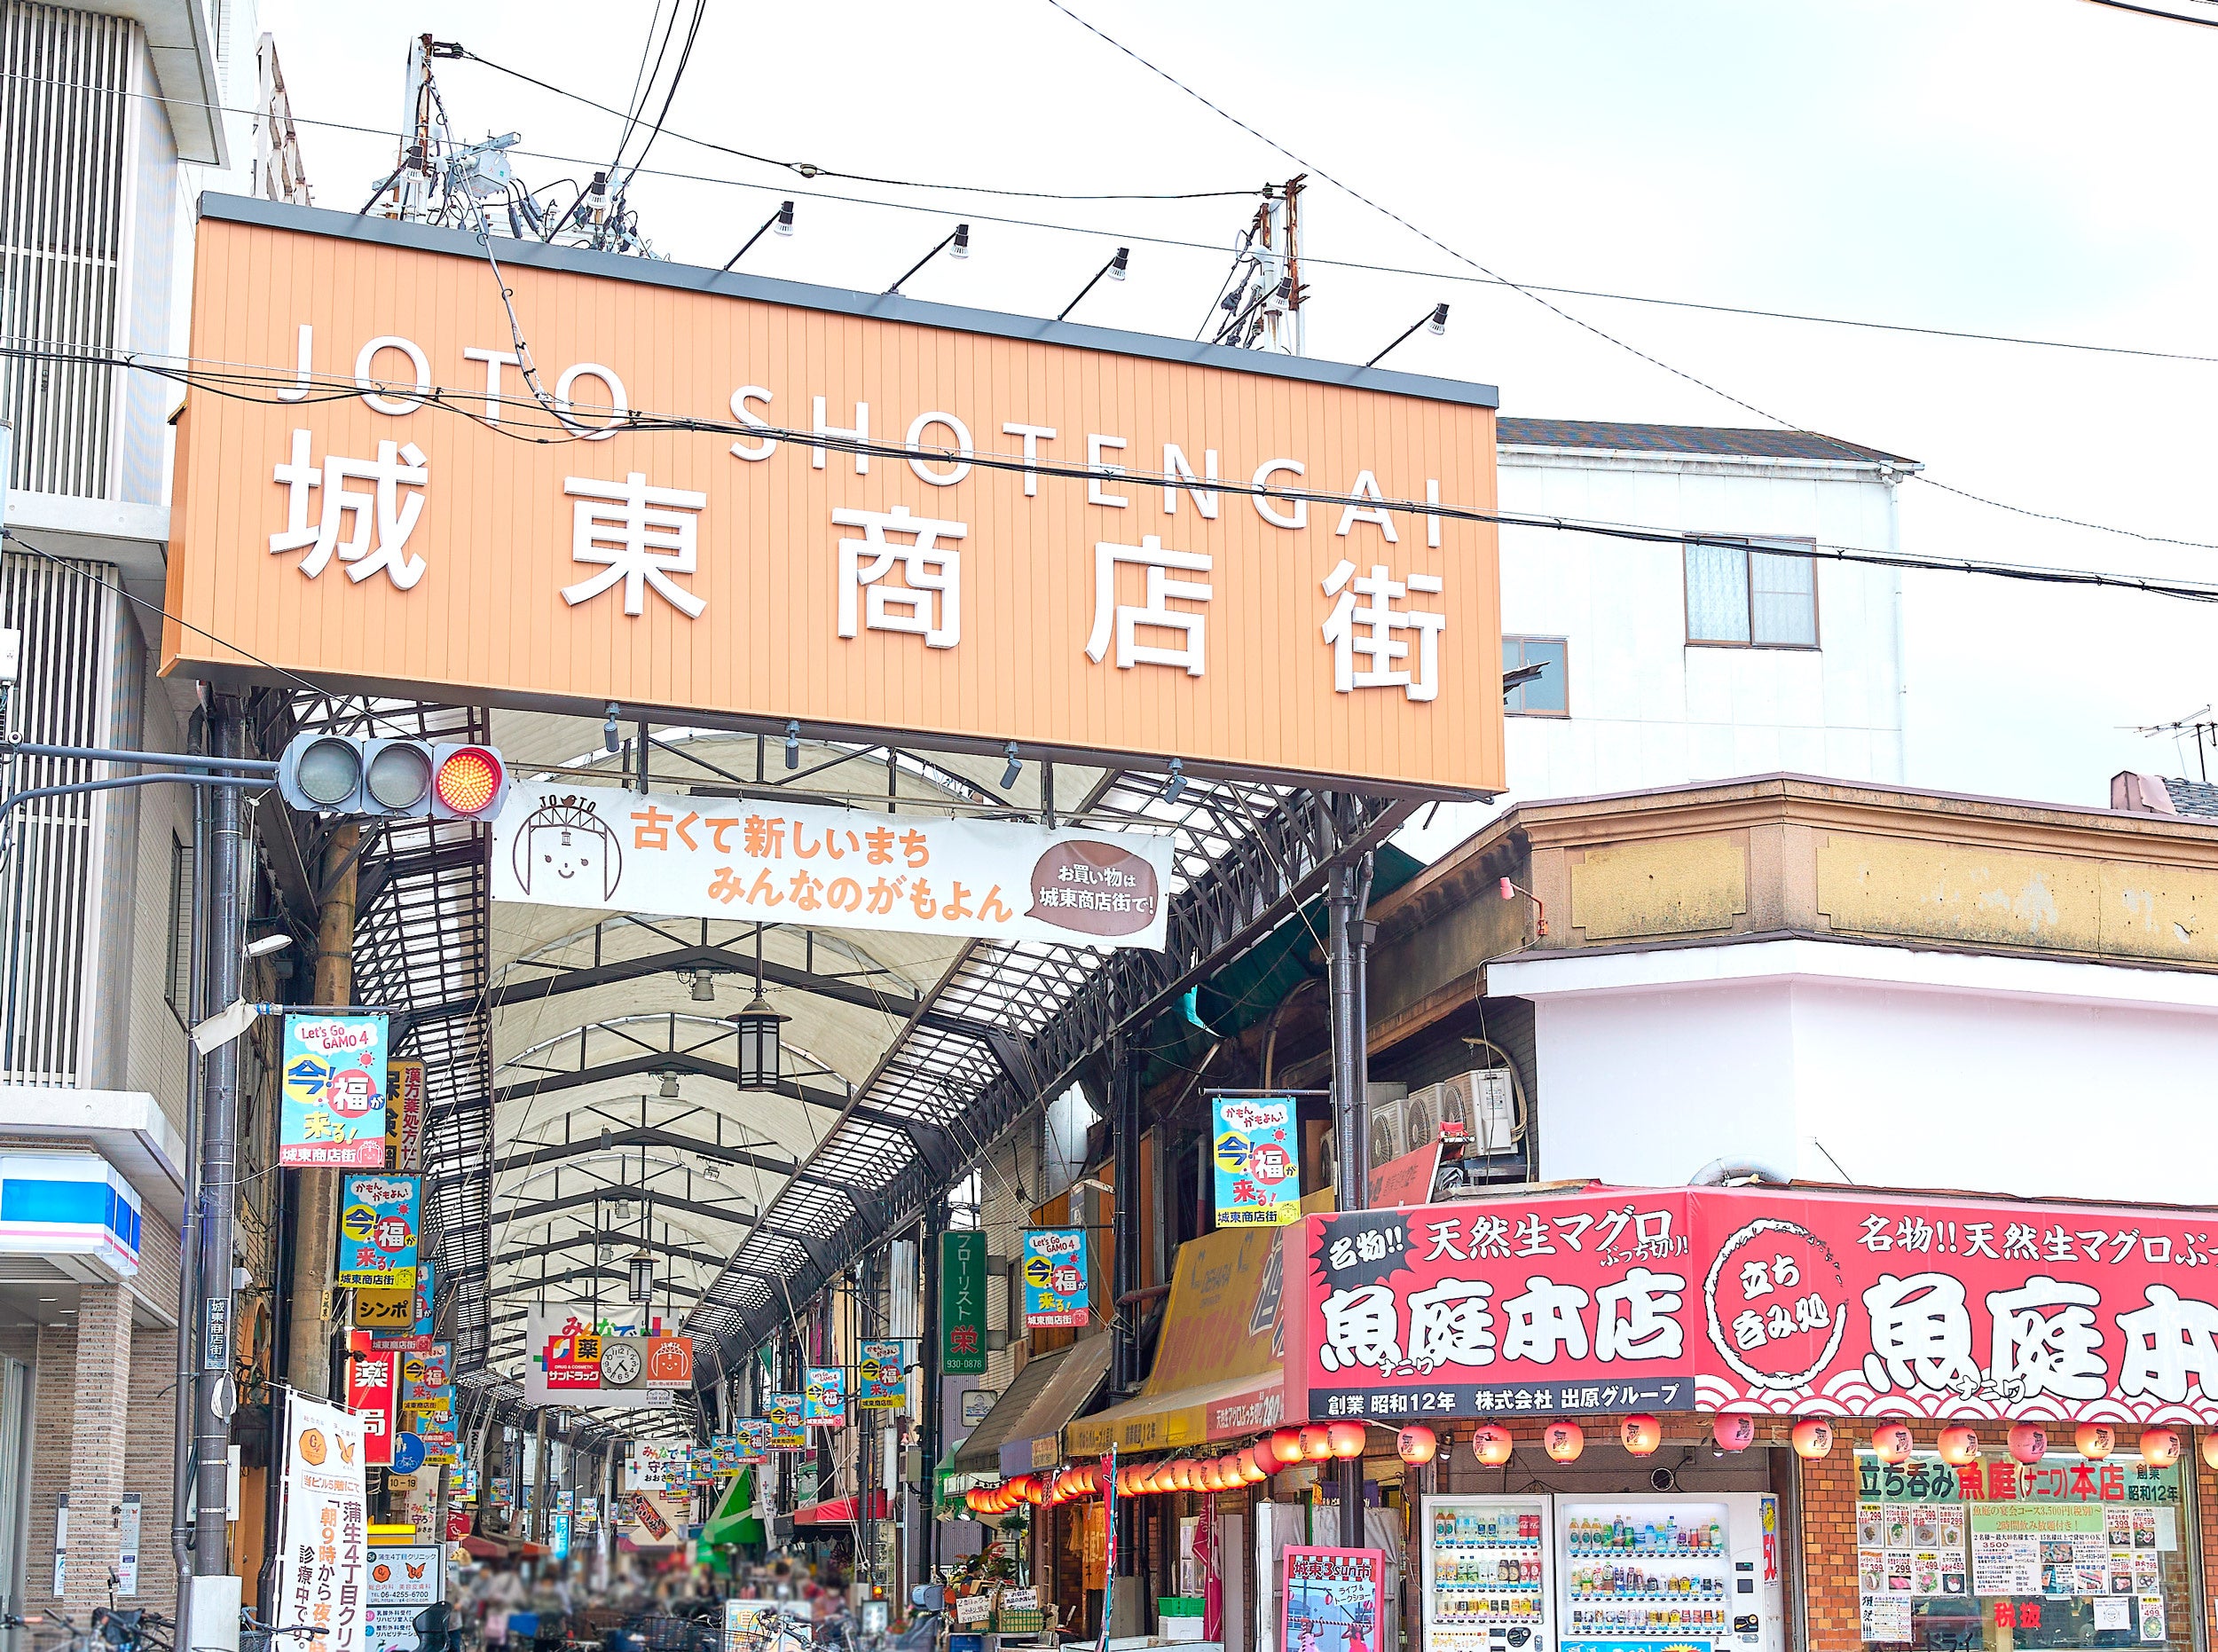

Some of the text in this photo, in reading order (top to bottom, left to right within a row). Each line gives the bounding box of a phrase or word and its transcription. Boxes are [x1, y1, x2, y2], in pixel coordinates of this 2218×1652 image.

[277, 324, 1441, 548] JOTO SHOTENGAI
[269, 429, 1446, 703] 城東商店街
[630, 806, 931, 869] 古くて新しいまち
[1058, 863, 1137, 888] お買い物は
[707, 867, 1013, 924] みんなのがもよん
[1039, 886, 1155, 915] 城東商店街で!
[302, 1025, 345, 1040] Let's Go
[323, 1031, 368, 1050] GAMO 4
[1226, 1106, 1253, 1118] かもん
[1244, 1112, 1284, 1128] がもよん!
[304, 1112, 358, 1145] 来る!
[282, 1148, 357, 1163] 城東商店街
[356, 1183, 382, 1193] かもん
[373, 1189, 409, 1201] がもよん!
[1233, 1179, 1277, 1208] 来る!
[1217, 1211, 1278, 1223] 城東商店街
[1034, 1239, 1050, 1247] Let's
[1423, 1204, 1673, 1262] 天然生マグロ
[1046, 1239, 1074, 1253] GAMO 4
[1329, 1225, 1404, 1271] 名物!!
[1601, 1235, 1688, 1267] ぶっち切り!
[357, 1247, 397, 1271] 来る!
[341, 1274, 395, 1286] 城東商店街
[1740, 1255, 1801, 1302] 立ち
[951, 1235, 978, 1354] フローリスト 栄
[1038, 1293, 1072, 1313] 来る!
[359, 1300, 409, 1318] シンポ
[1027, 1315, 1072, 1325] 城東商店街
[1320, 1267, 1687, 1373] 魚庭本店
[209, 1301, 224, 1356] 城東商店街
[1732, 1292, 1830, 1351] 呑み処
[373, 1340, 416, 1349] 城東商店街
[578, 1339, 598, 1359] 薬
[1863, 1272, 2218, 1404] 魚庭本
[549, 1371, 599, 1381] サンドラッグ
[1380, 1356, 1435, 1378] ナニワ
[355, 1361, 388, 1436] 薬局
[1327, 1382, 1681, 1416] 創業 昭和12年 株式会社 出原グループ
[2136, 1464, 2160, 1480] 創業
[2128, 1484, 2178, 1502] 昭和12年
[338, 1501, 362, 1652] 蒲生4丁目クリ
[1294, 1561, 1372, 1578] 城東3sun市
[1335, 1593, 1371, 1604] トークショー
[1339, 1585, 1357, 1594] ライブ
[1994, 1602, 2041, 1628] 税抜
